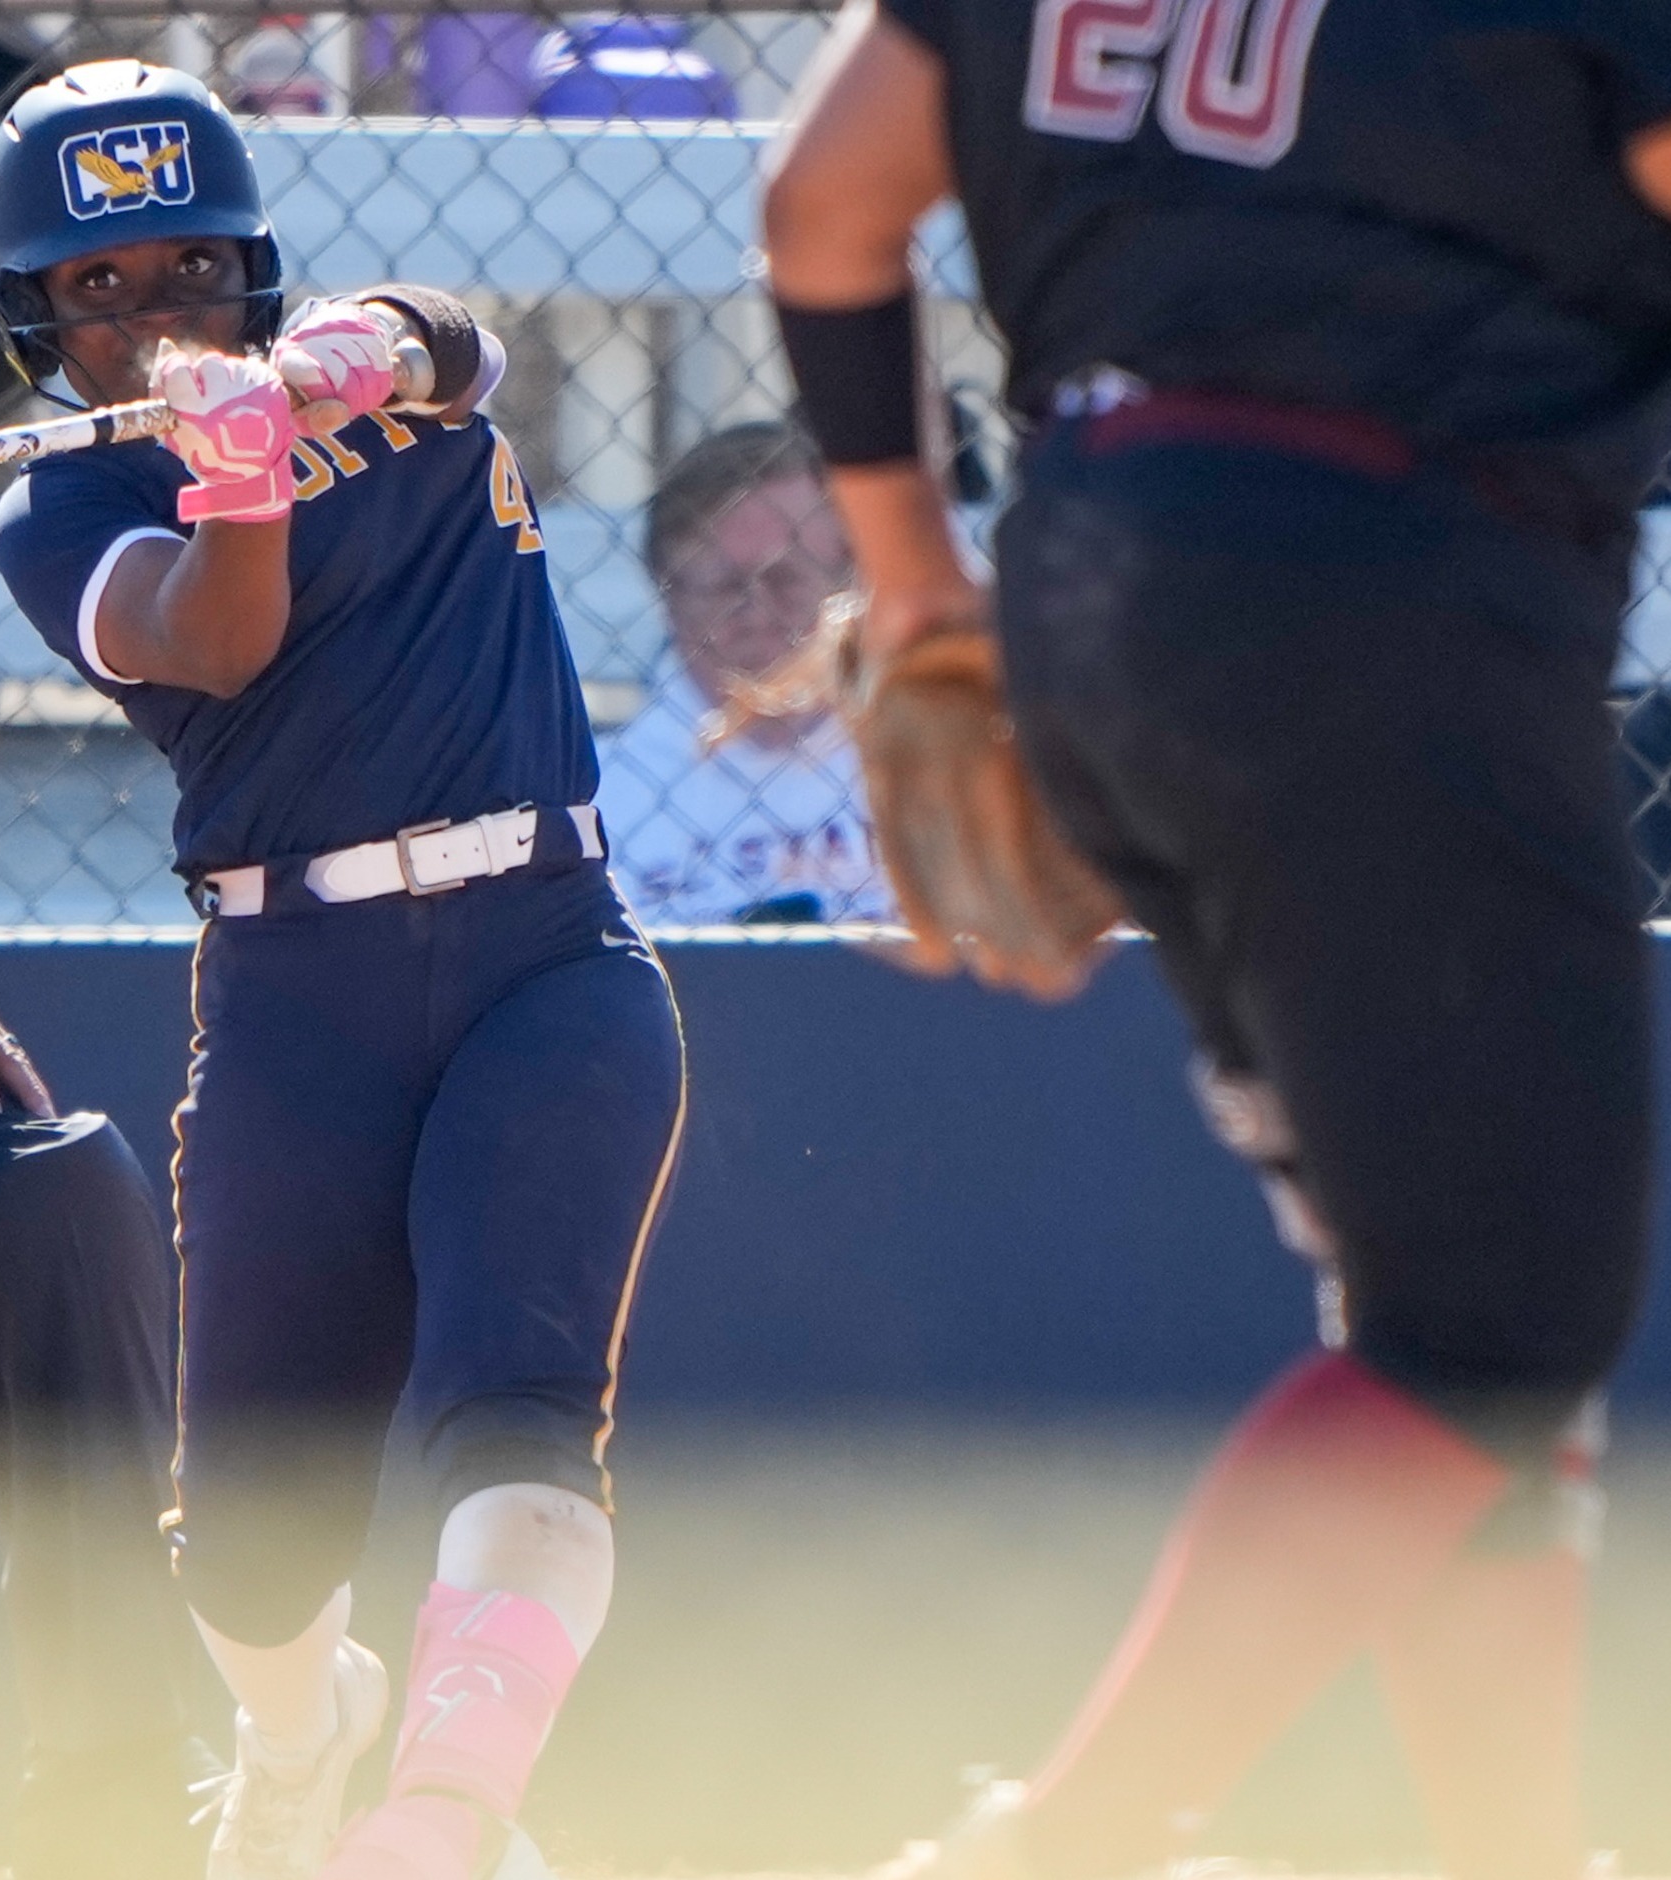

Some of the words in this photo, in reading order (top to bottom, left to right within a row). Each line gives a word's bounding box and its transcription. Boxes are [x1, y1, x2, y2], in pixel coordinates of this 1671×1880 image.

[1022, 0, 1327, 170] 20
[57, 121, 195, 221] CSU
[489, 423, 545, 554] 4
